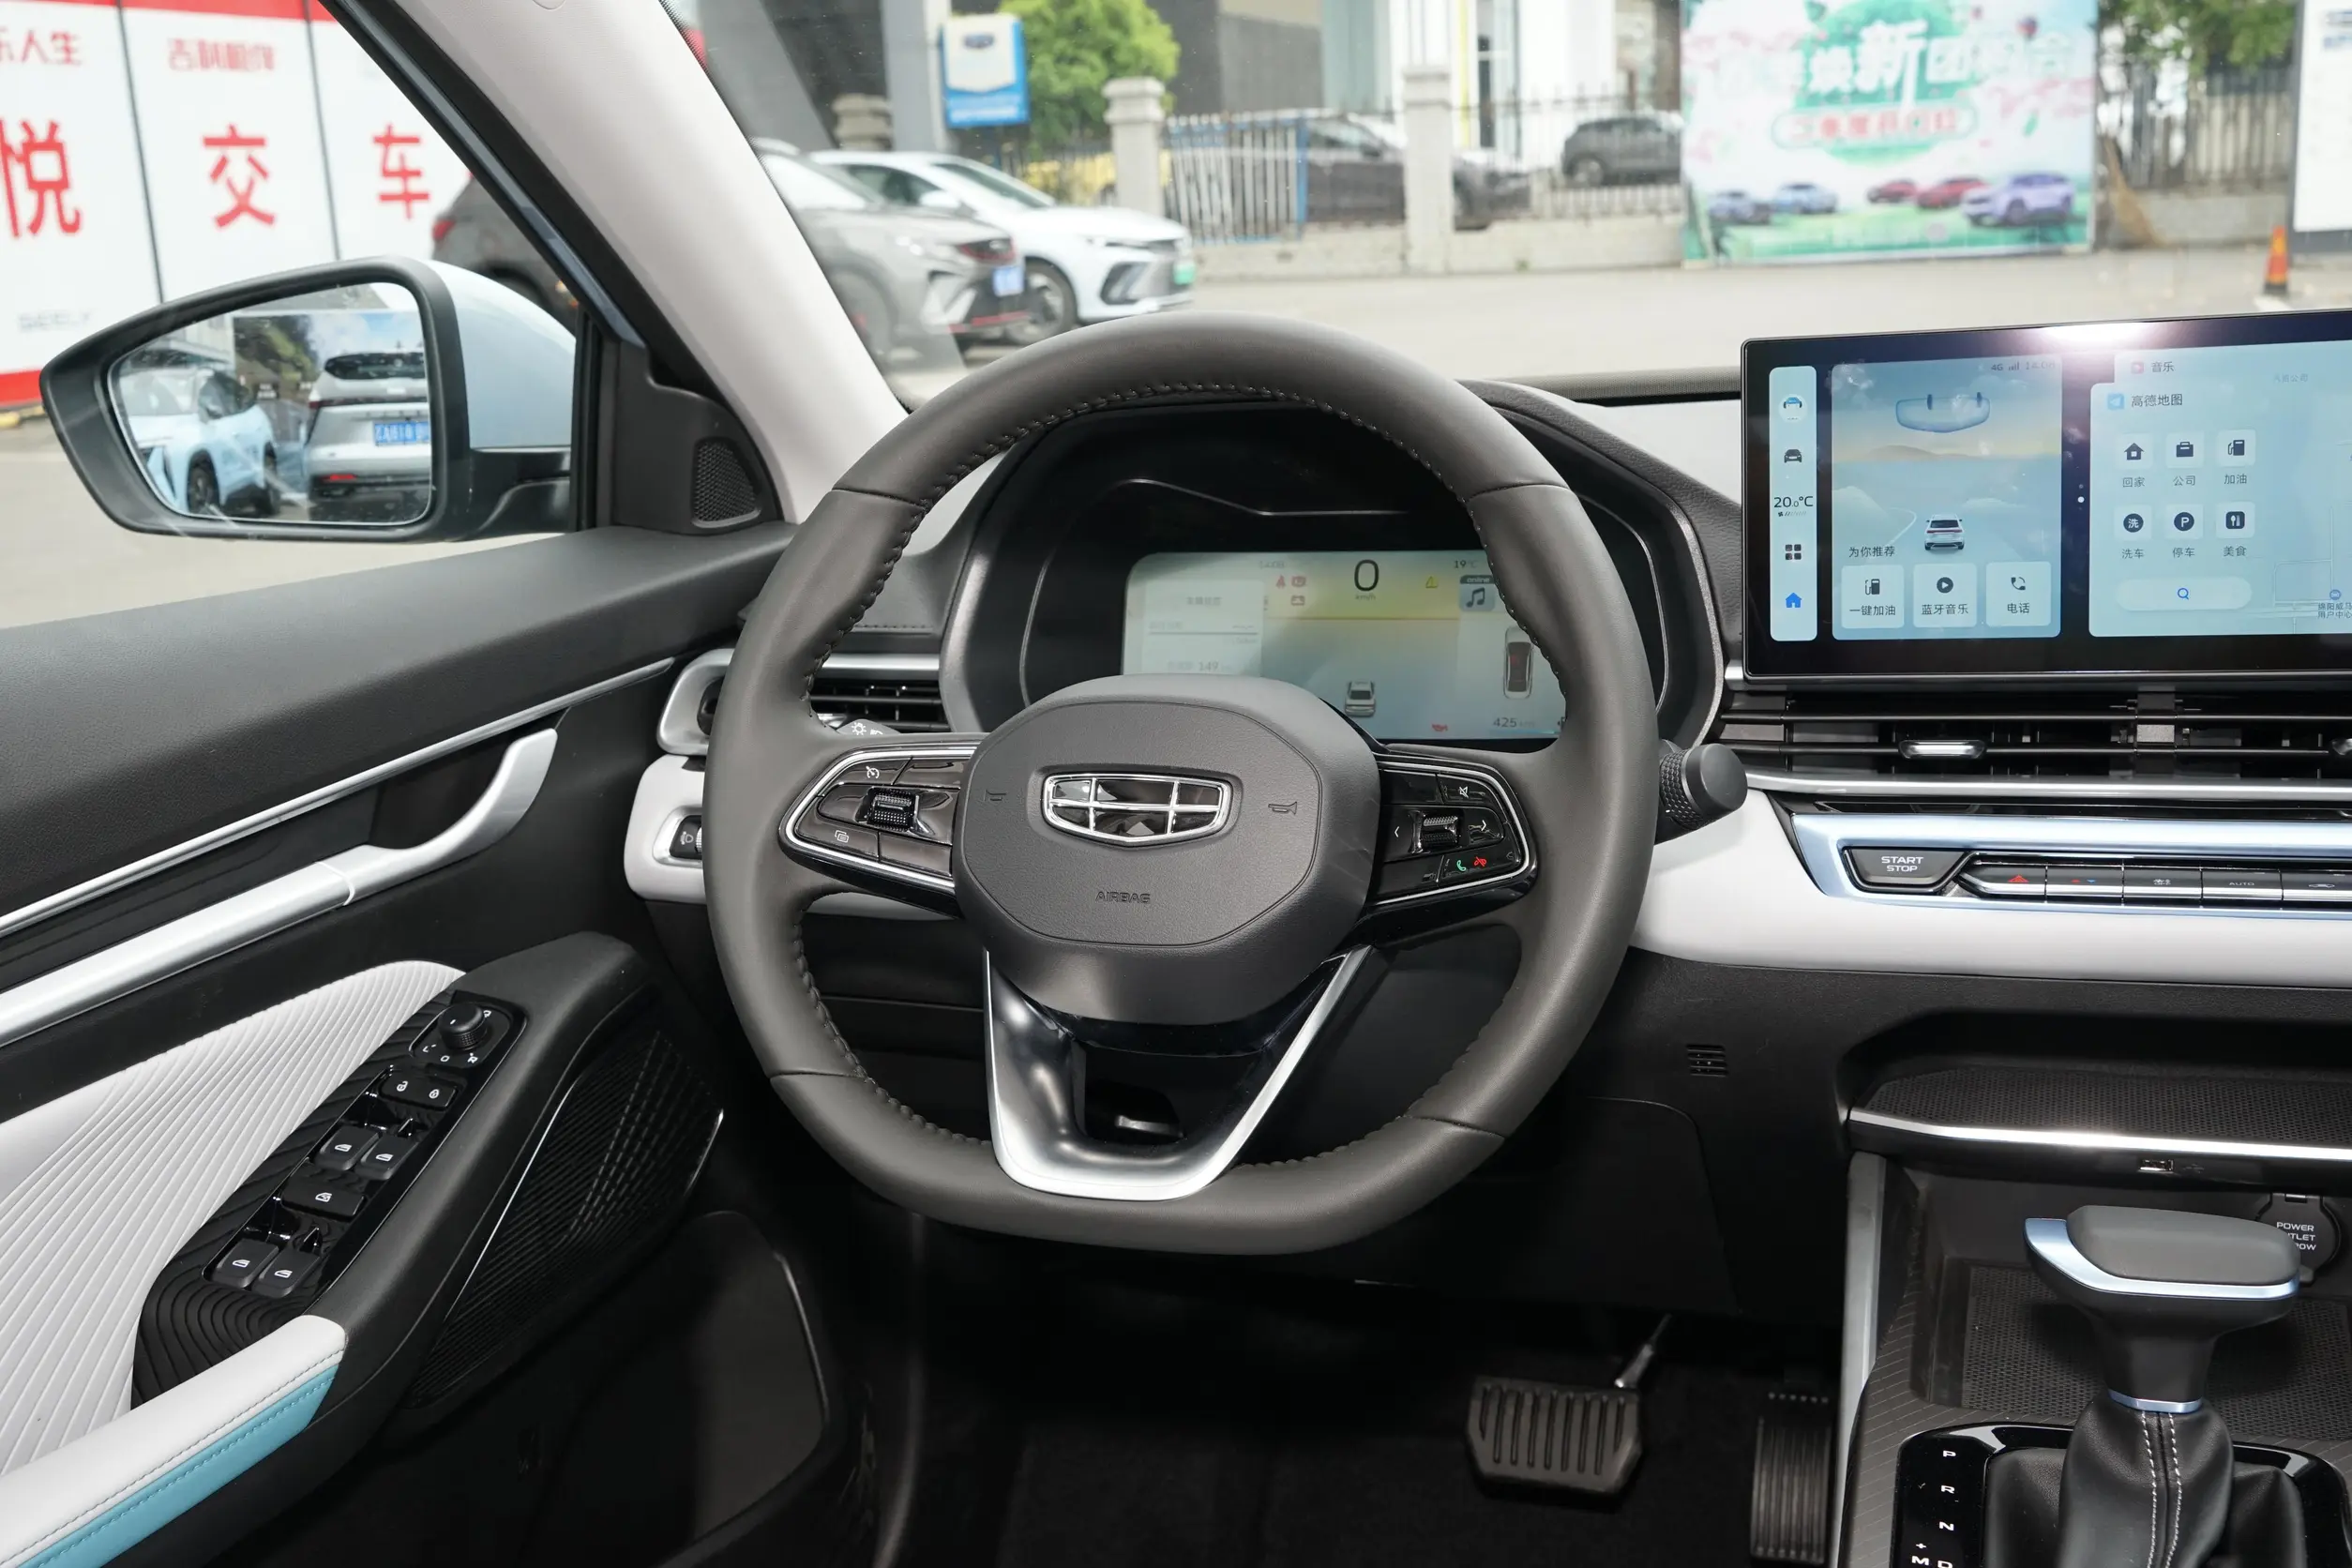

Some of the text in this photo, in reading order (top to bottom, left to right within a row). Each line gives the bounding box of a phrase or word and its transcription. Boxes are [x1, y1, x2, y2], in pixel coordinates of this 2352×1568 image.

[202, 124, 276, 228] 交
[373, 123, 430, 220] 车
[1991, 363, 2004, 371] 4G
[2151, 361, 2175, 373] 音乐
[2131, 393, 2183, 408] 高德地图
[2122, 476, 2146, 488] 回家
[2173, 475, 2196, 486] 公司
[2224, 474, 2248, 485] 加油
[1848, 546, 1896, 559] 为你推荐
[2121, 548, 2145, 559] 洗车
[2172, 547, 2195, 558] 停车
[2223, 546, 2247, 557] 美食
[1353, 559, 1380, 592] 0
[1848, 605, 1896, 617] 一键加油
[1921, 603, 1969, 616] 蓝牙音乐
[2007, 602, 2030, 614] 电话
[1493, 716, 1517, 728] 425
[1880, 855, 1924, 865] START
[1095, 891, 1151, 904] AIRBAG
[2276, 1221, 2314, 1231] POWER
[1940, 1485, 1955, 1495] R
[1938, 1520, 1954, 1531] N
[1911, 1555, 1953, 1568] M D
